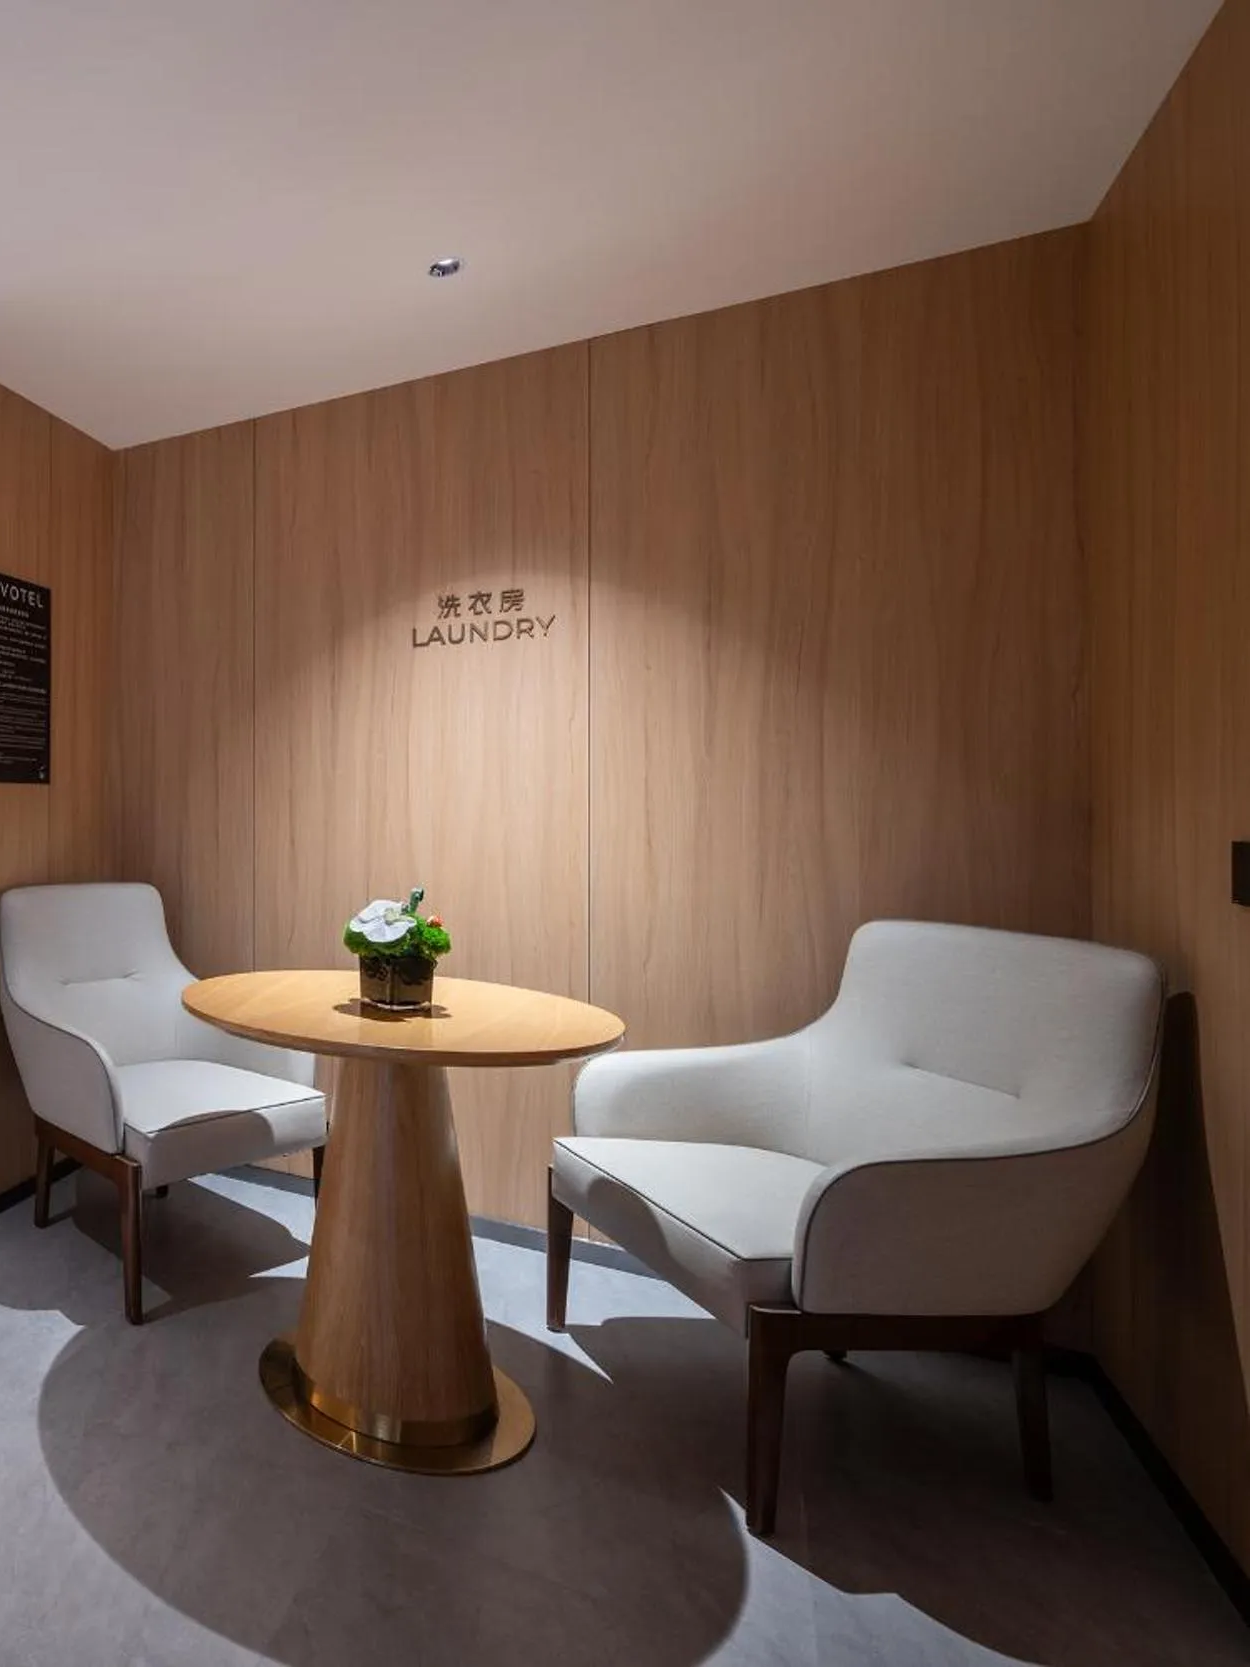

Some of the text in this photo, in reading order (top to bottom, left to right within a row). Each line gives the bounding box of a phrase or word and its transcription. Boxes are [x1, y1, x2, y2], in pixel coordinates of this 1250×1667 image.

[437, 589, 525, 619] 洗衣房
[412, 615, 556, 648] LAUNDRY
